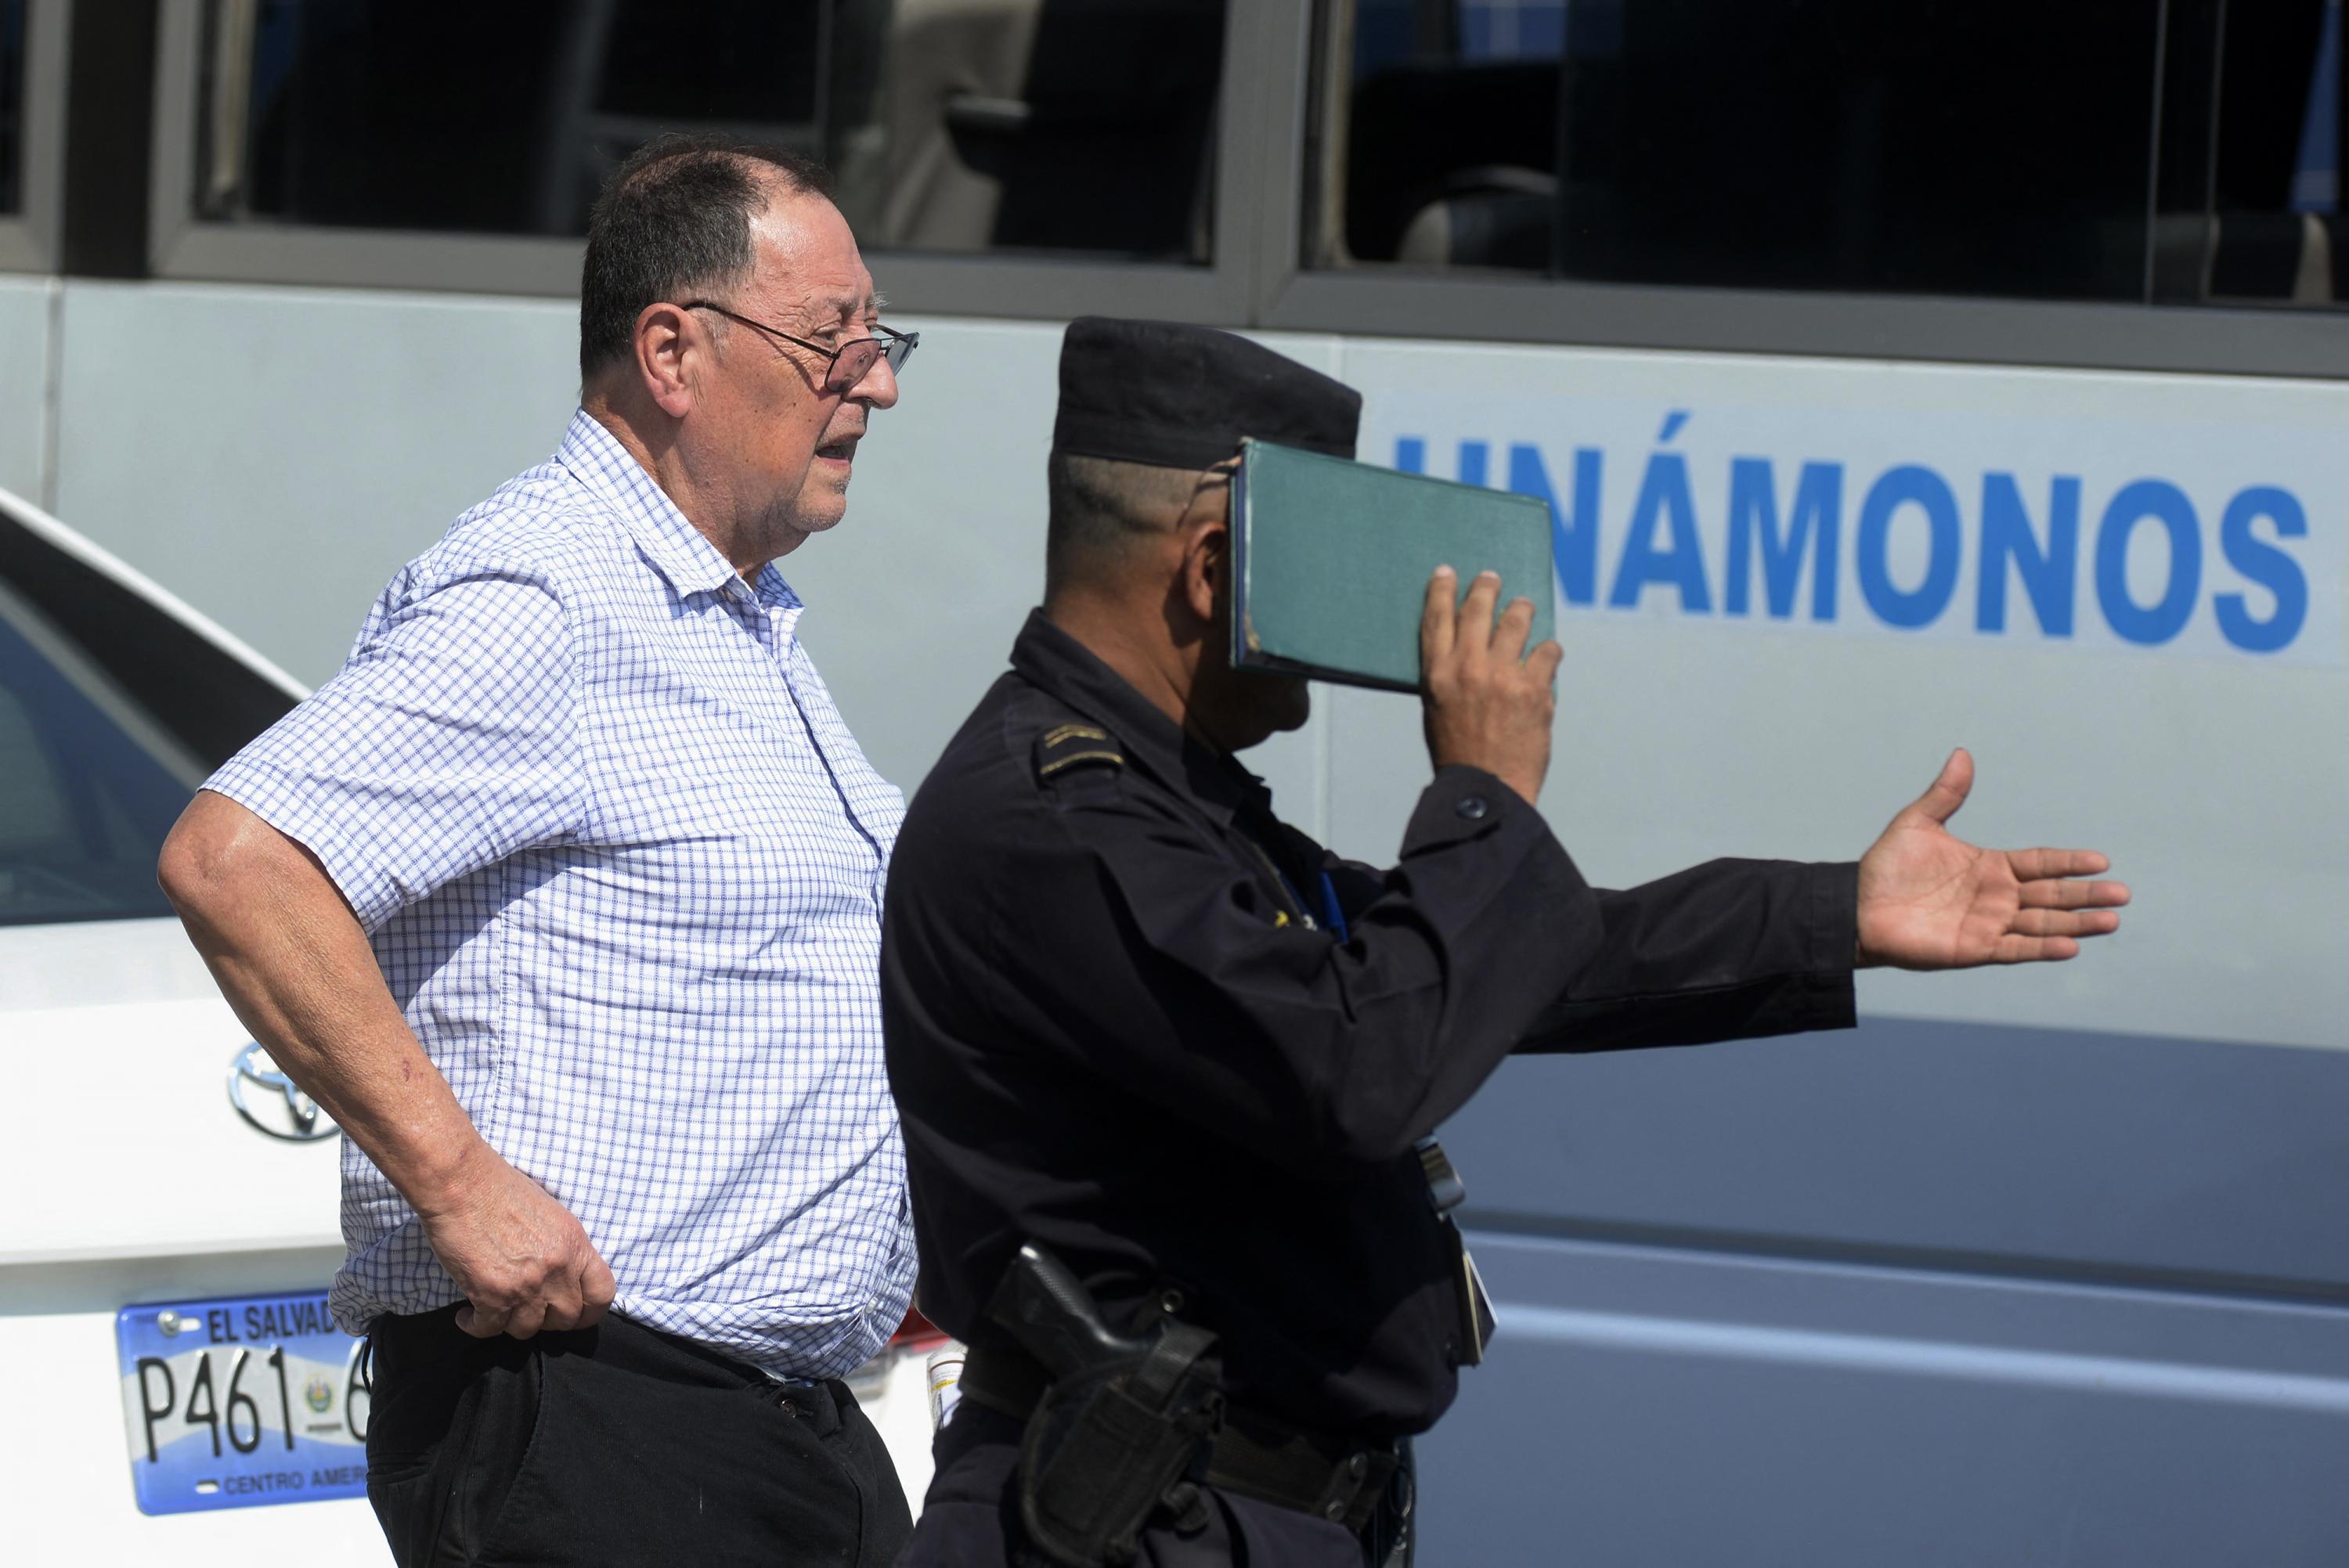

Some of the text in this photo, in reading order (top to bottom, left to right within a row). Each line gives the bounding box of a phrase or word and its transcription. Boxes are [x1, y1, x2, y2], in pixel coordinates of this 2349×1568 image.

[1394, 409, 2308, 655] NÁMONOS
[207, 1310, 239, 1343] EL
[137, 1346, 295, 1464] P461
[224, 1470, 305, 1496] CENTRO
